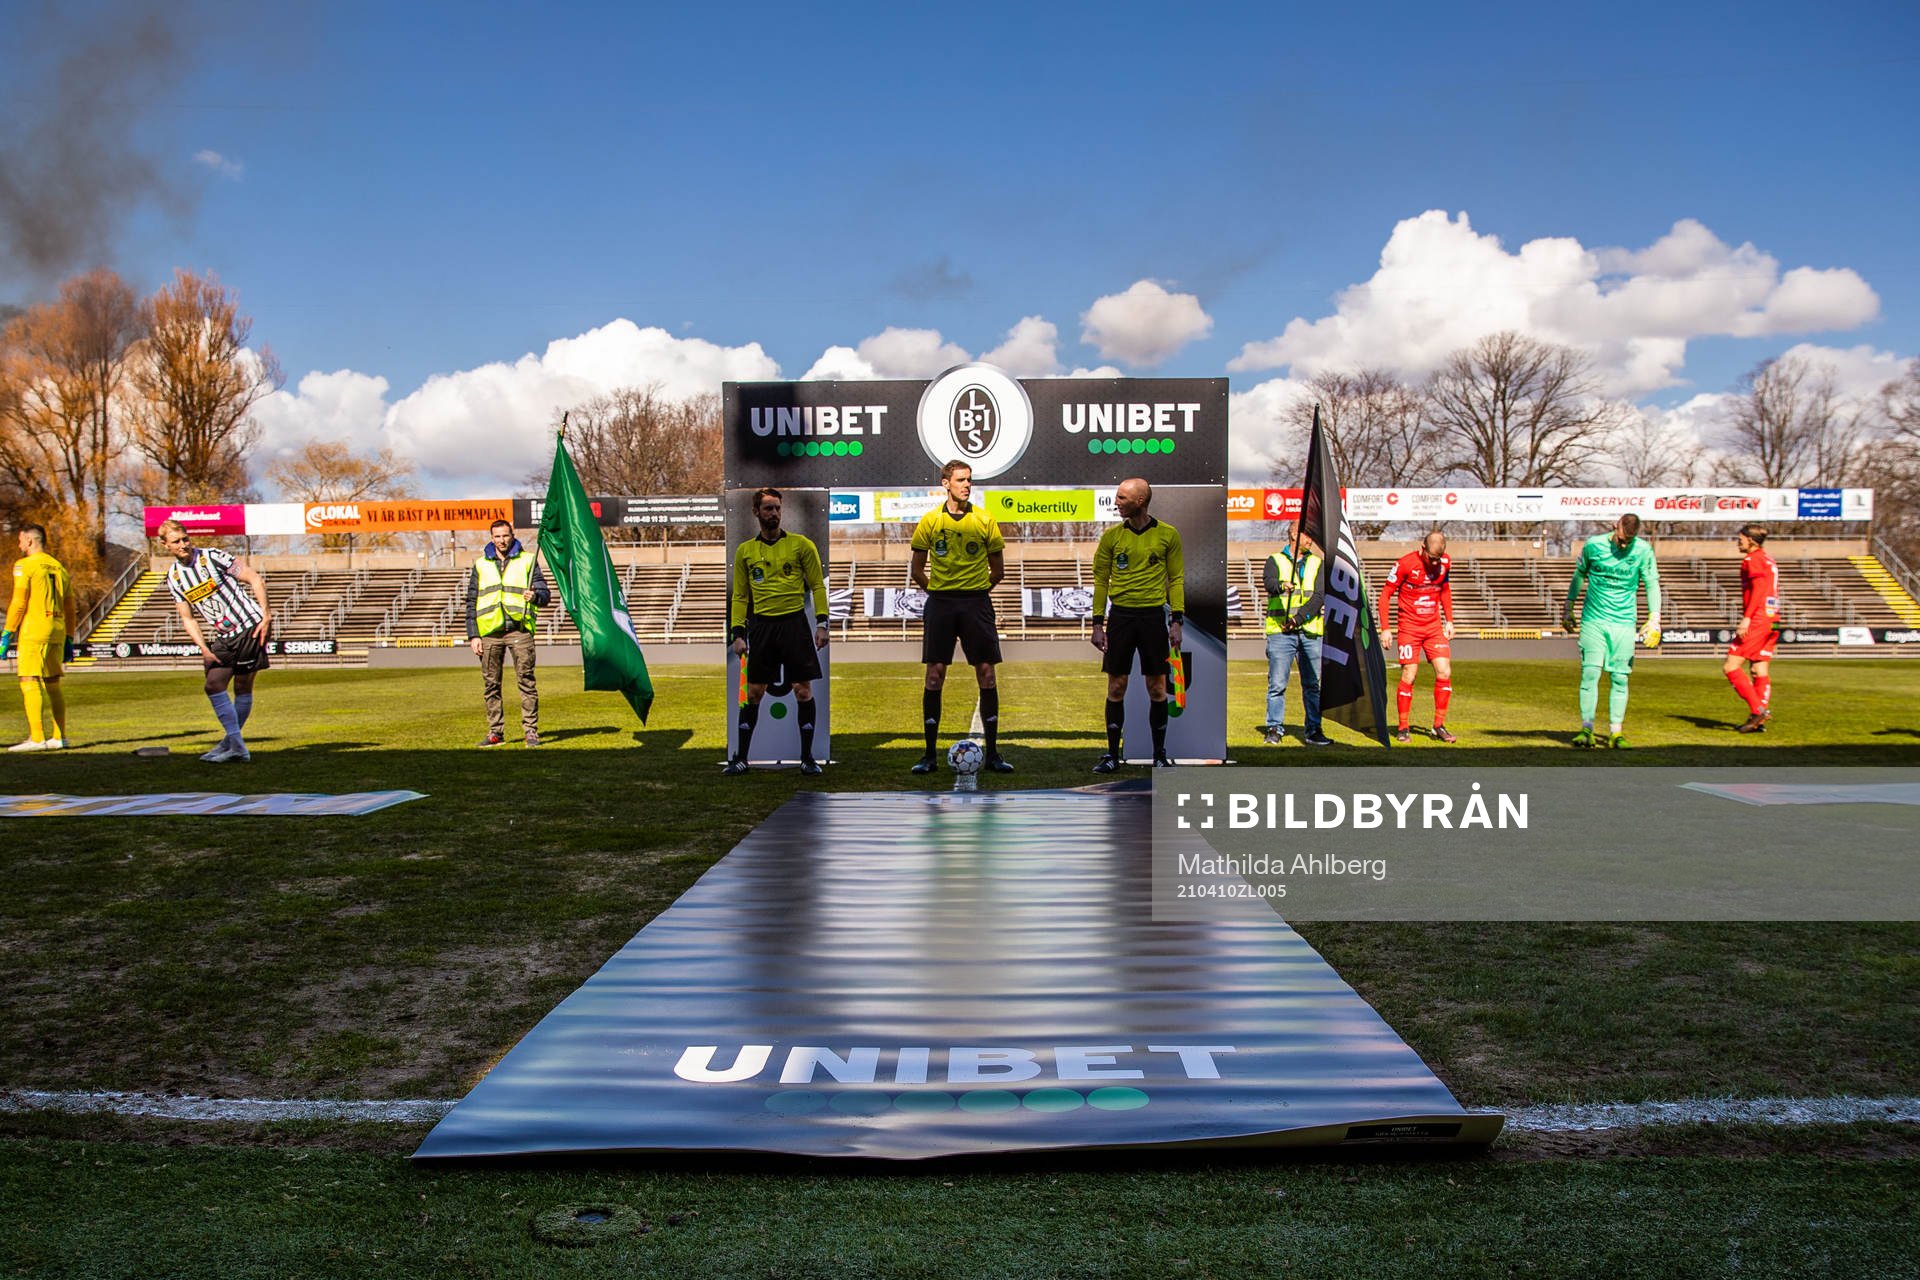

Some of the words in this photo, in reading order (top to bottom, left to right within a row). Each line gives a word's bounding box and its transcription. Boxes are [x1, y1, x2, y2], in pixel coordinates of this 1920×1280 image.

[750, 405, 888, 436] UNIBET
[1062, 403, 1200, 433] UNIBET
[1017, 501, 1078, 515] bakertilly
[1560, 496, 1646, 506] RINGSERVICE
[1717, 498, 1761, 510] CITY
[321, 505, 361, 519] LOKAL
[367, 510, 377, 522] VI
[444, 508, 506, 520] HEMMAPLAN
[1465, 503, 1543, 514] WILENSKY
[1662, 630, 1711, 643] stadium
[138, 643, 203, 657] Volkswagen
[284, 641, 334, 653] SERNEKE
[1399, 644, 1413, 660] 20
[673, 1045, 1237, 1084] UNIBET
